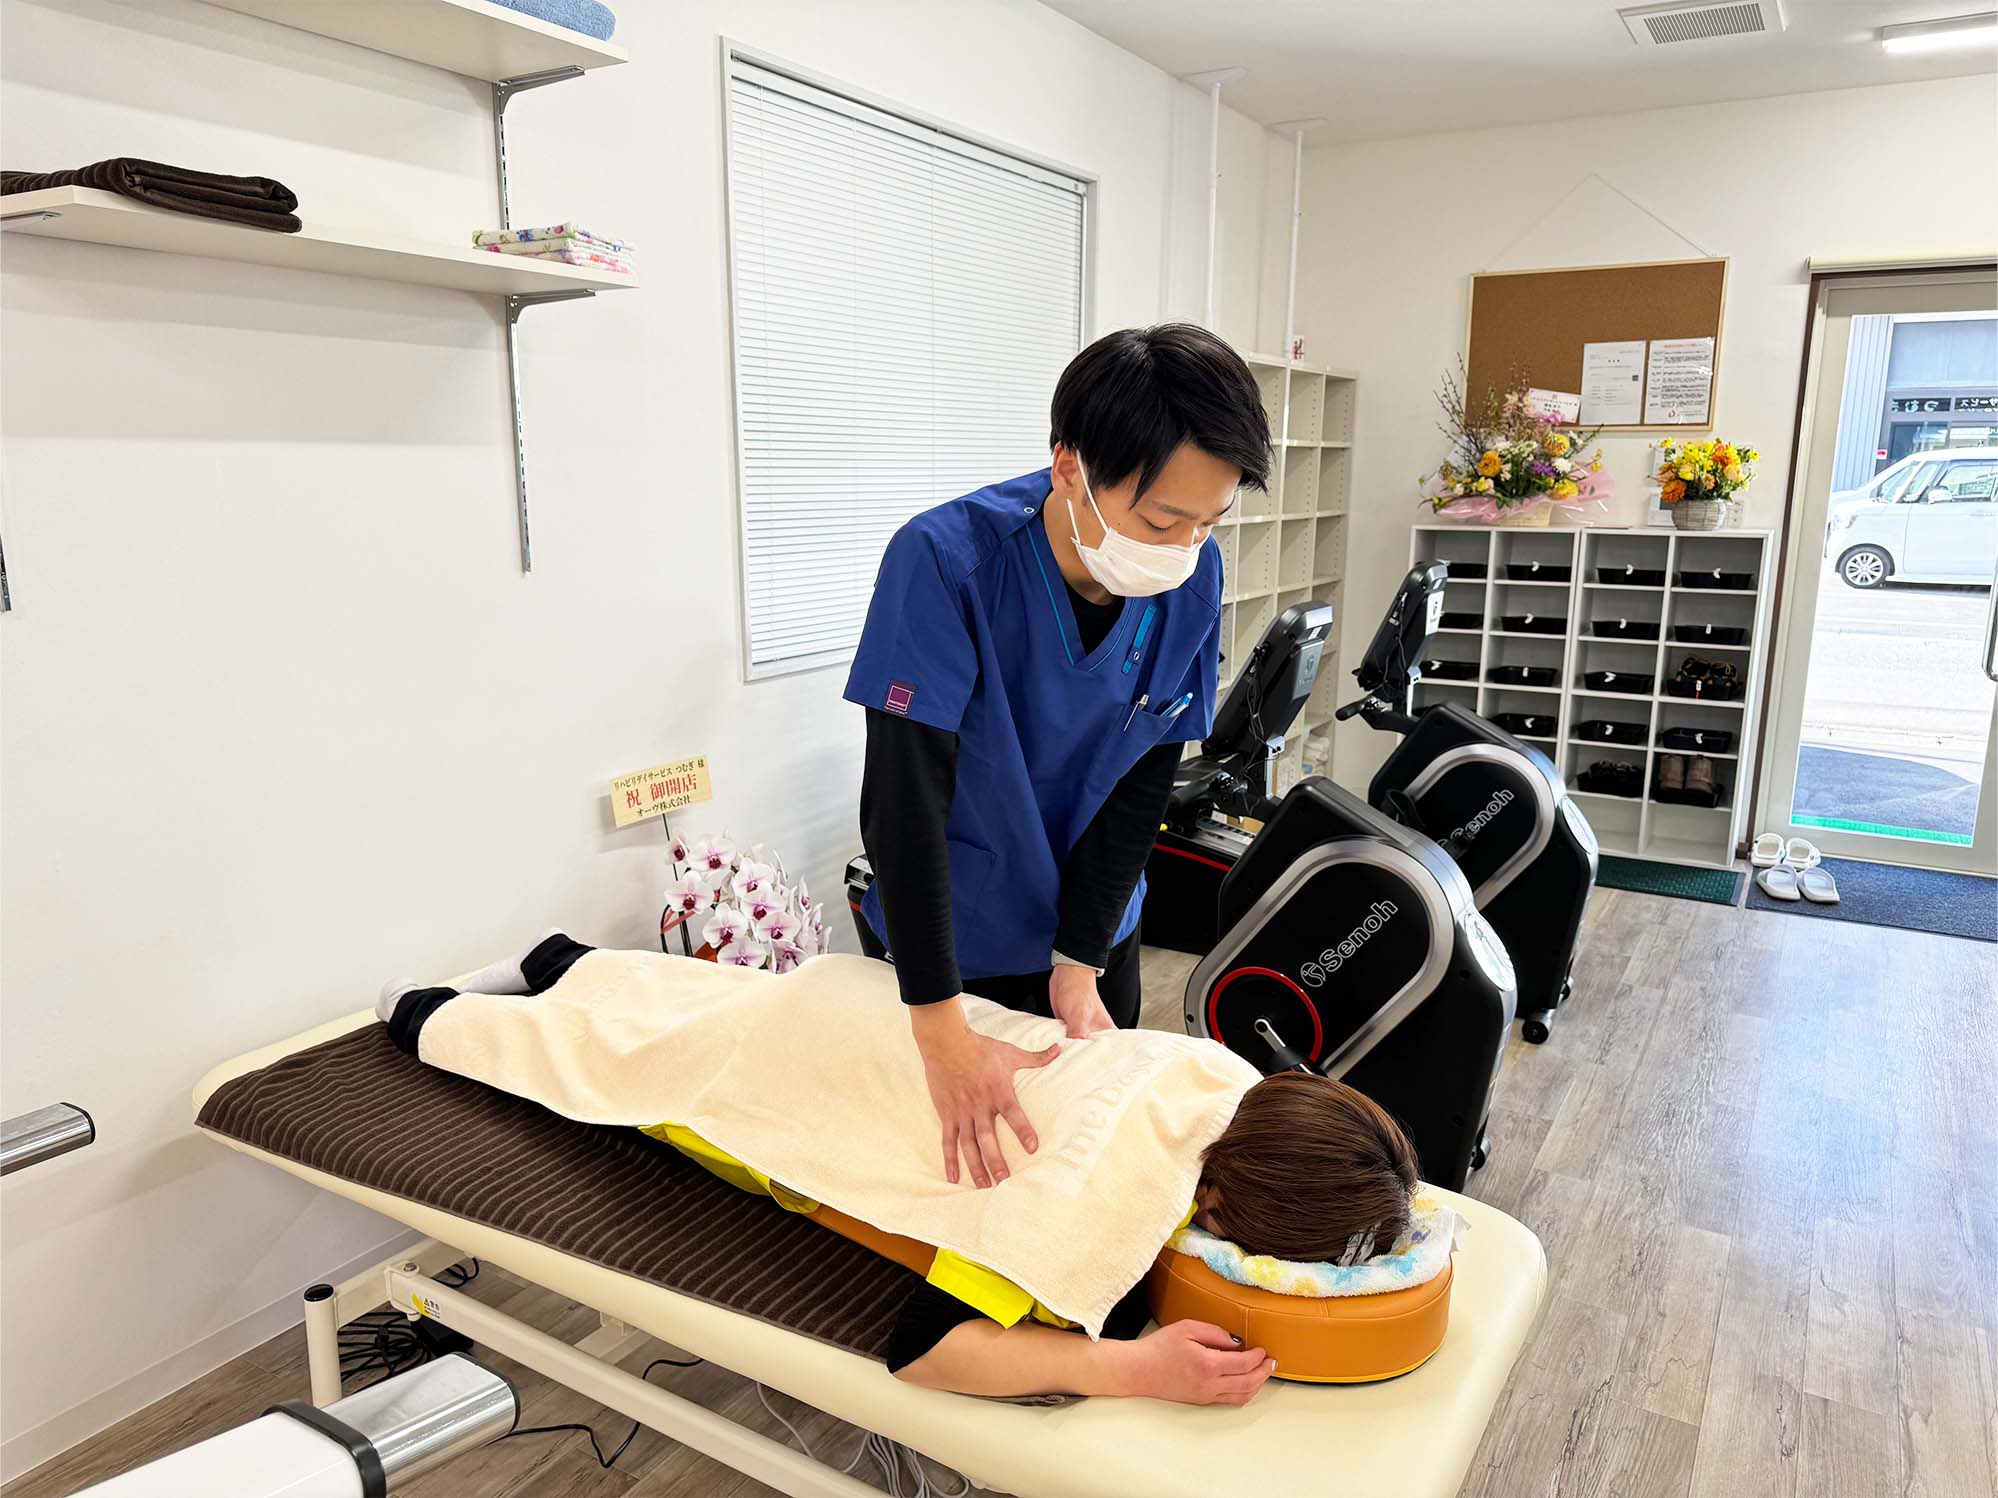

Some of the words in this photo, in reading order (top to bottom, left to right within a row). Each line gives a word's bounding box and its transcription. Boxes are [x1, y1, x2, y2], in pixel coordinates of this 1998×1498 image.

[626, 789, 642, 808] 祝
[650, 773, 697, 801] 御開店
[1318, 900, 1399, 973] Senoh
